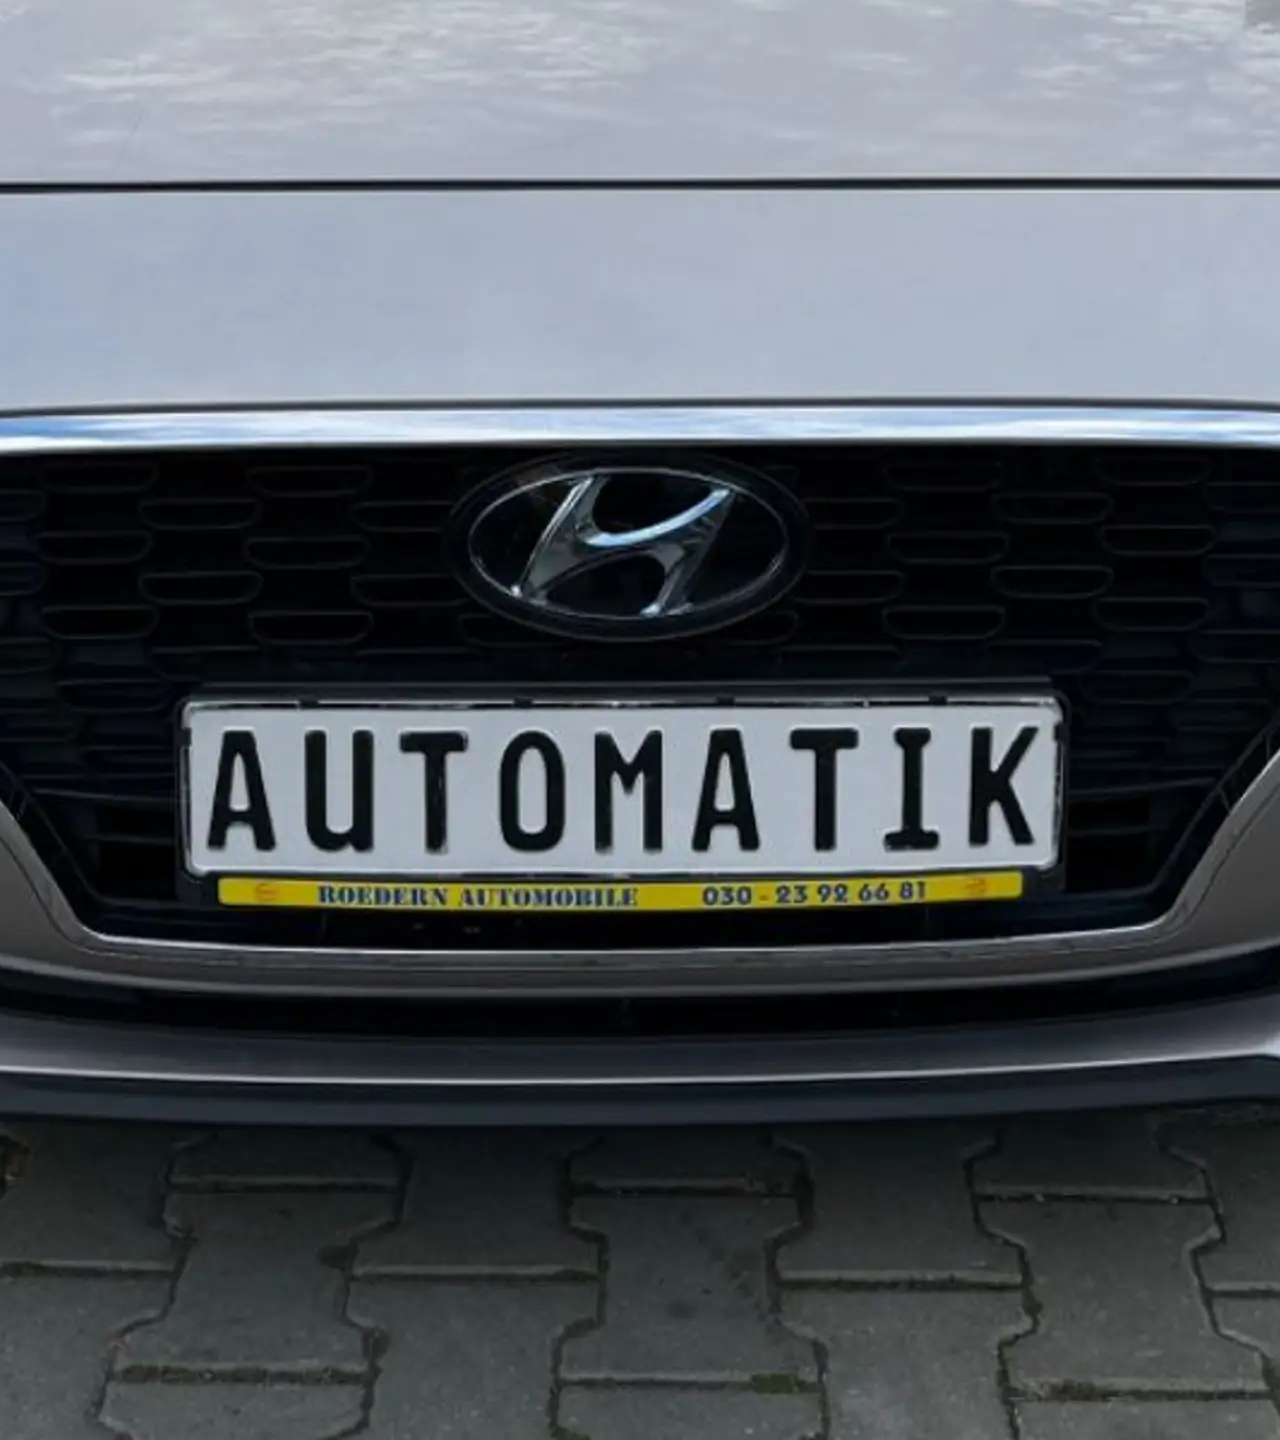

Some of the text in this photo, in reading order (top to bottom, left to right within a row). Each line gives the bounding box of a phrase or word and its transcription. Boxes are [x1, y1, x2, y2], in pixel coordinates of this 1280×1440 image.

[205, 724, 1040, 855] AUTOMATIK
[318, 884, 449, 907] ROEDERN
[458, 885, 640, 910] AUTOMOBILE
[701, 884, 753, 907] 030
[775, 883, 809, 905] 23
[817, 882, 849, 904] 92
[858, 881, 891, 903] 66
[898, 879, 927, 901] 81
